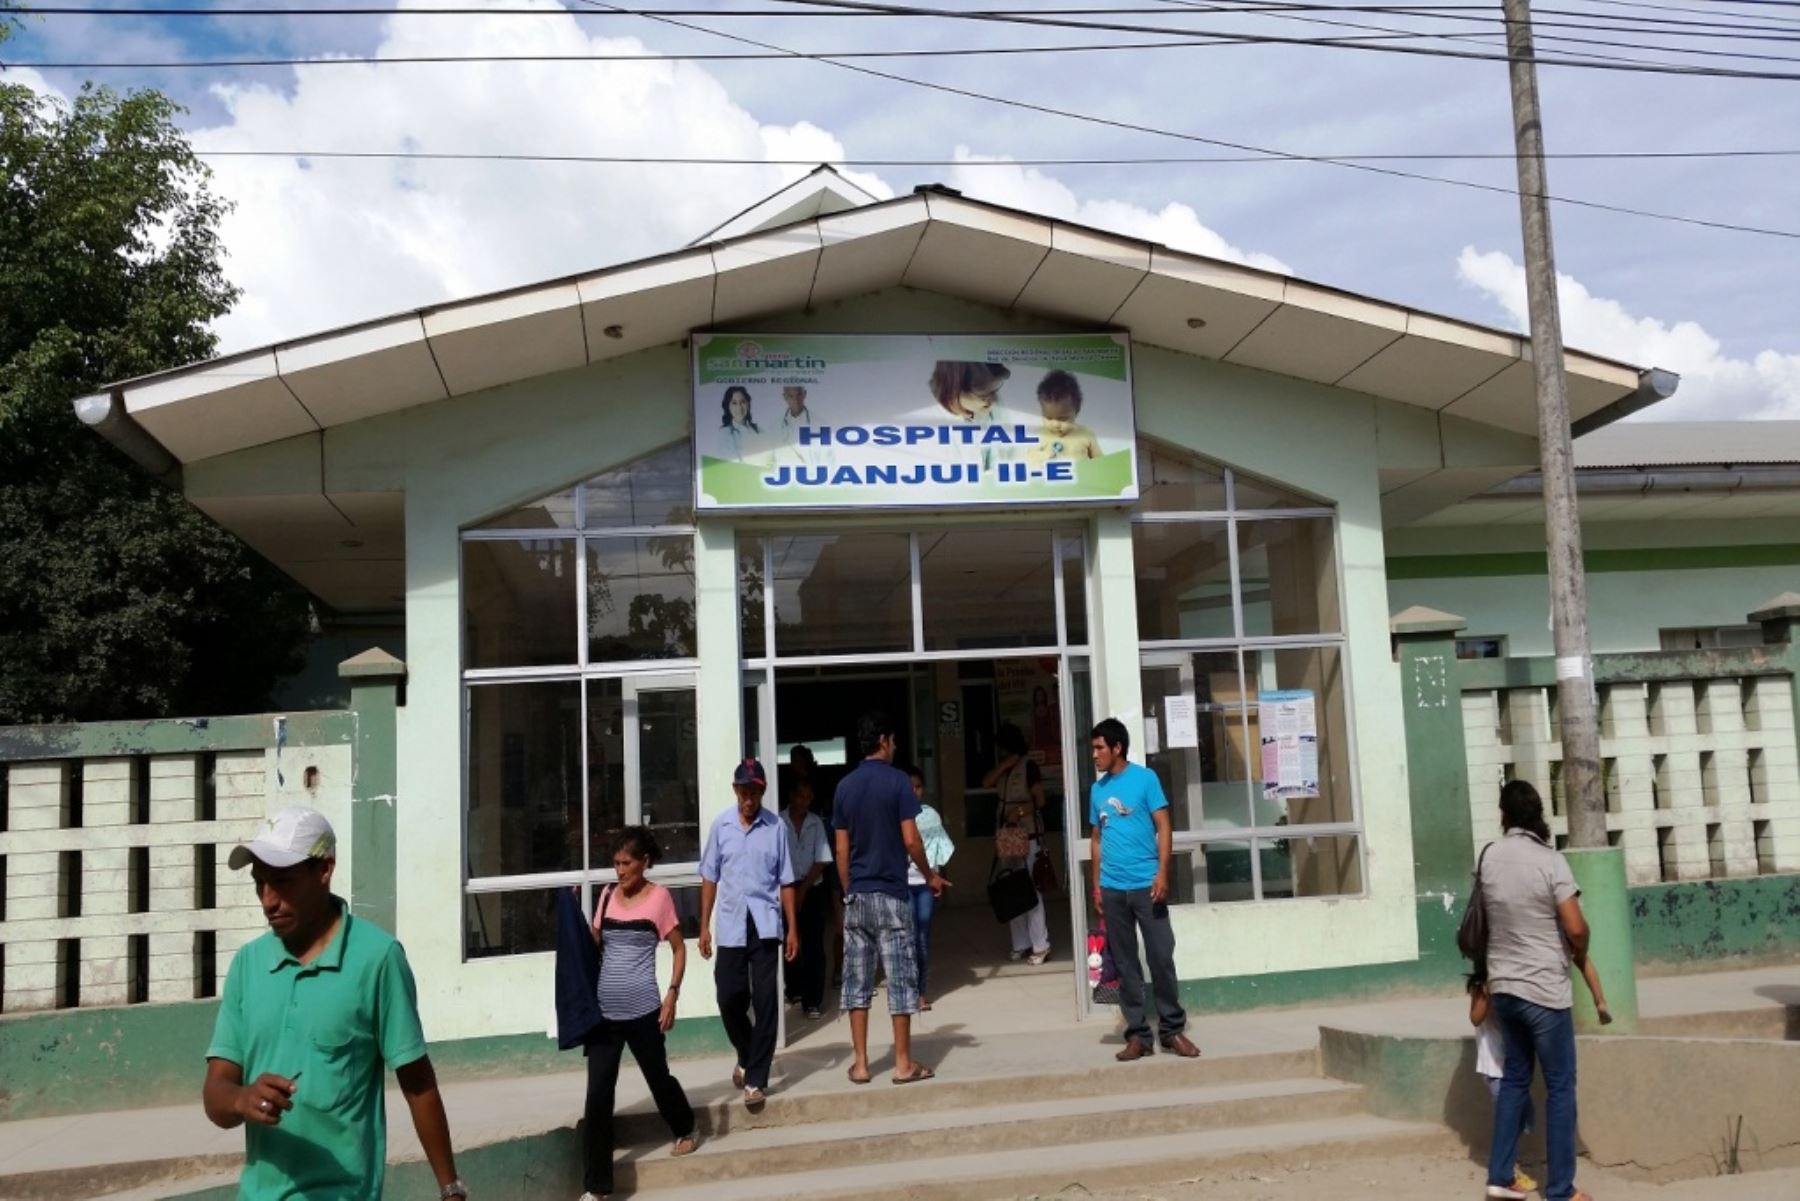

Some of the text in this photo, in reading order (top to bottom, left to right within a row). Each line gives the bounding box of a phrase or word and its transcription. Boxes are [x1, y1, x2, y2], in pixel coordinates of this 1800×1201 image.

[716, 376, 820, 385] GOBIERNO REGIONAL
[800, 424, 1040, 446] HOSPITAL
[764, 461, 1074, 486] JUANJUI II-E
[941, 702, 957, 721] S
